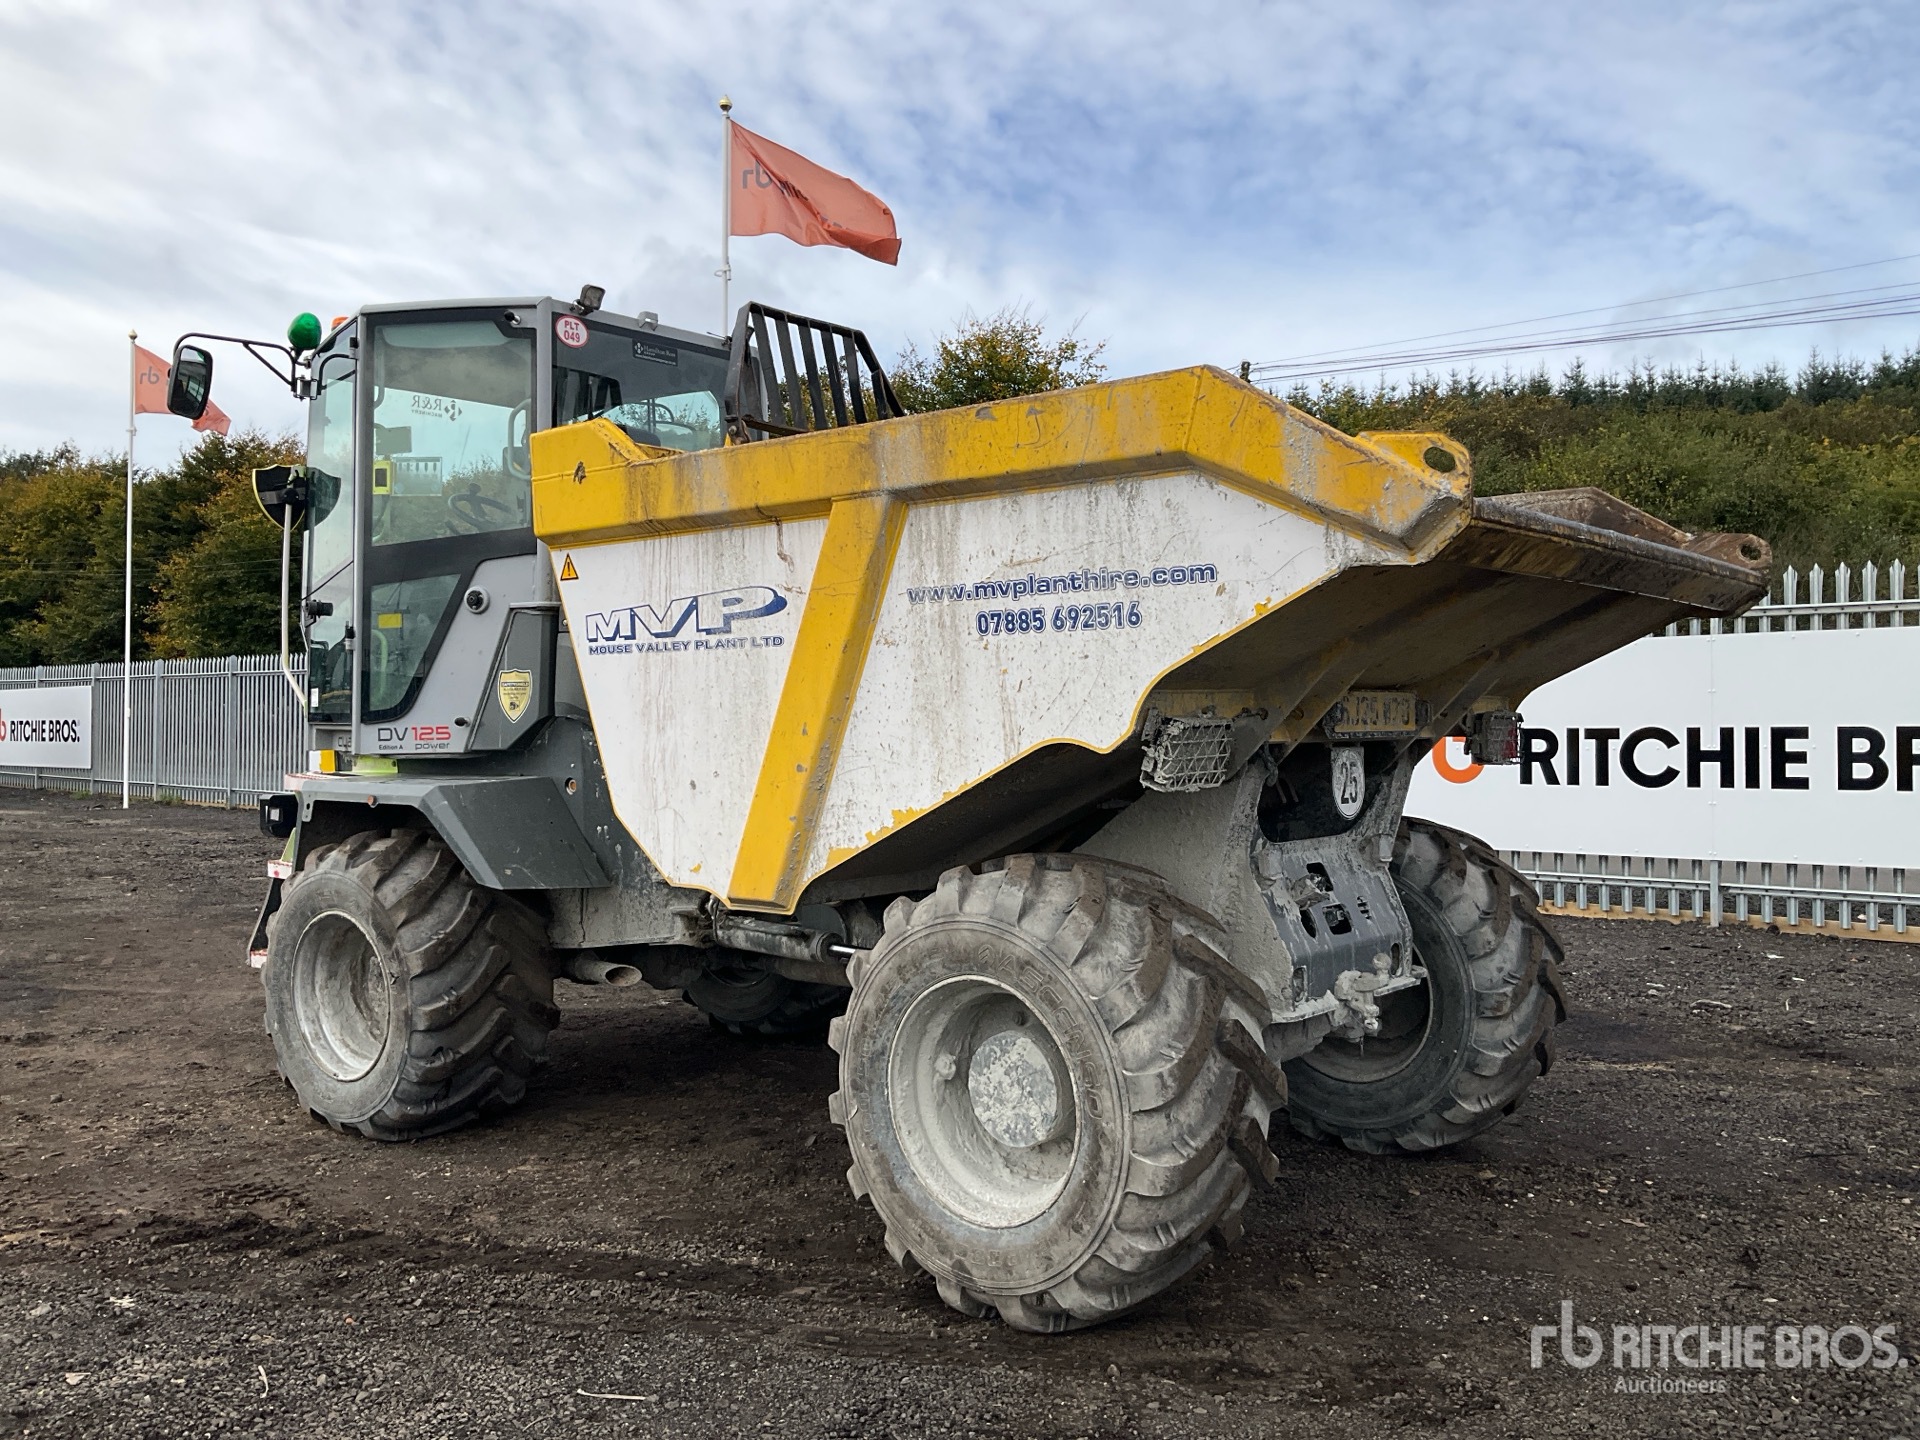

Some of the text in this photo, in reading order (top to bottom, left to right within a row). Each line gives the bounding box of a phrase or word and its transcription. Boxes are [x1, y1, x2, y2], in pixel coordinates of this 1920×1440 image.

[563, 330, 581, 343] 049
[564, 320, 580, 331] PLT
[139, 366, 160, 385] rb
[907, 563, 1218, 605] www.mvplanthire.com
[585, 585, 788, 643] MVP
[975, 601, 1143, 636] 07885 692516
[588, 635, 785, 656] MOUSE VALLEY PLANT LTD
[10, 719, 47, 742] RITCHIE
[48, 719, 80, 743] BROS.
[414, 742, 450, 750] power
[1518, 726, 1810, 790] RITCHIE
[1340, 762, 1358, 805] 25
